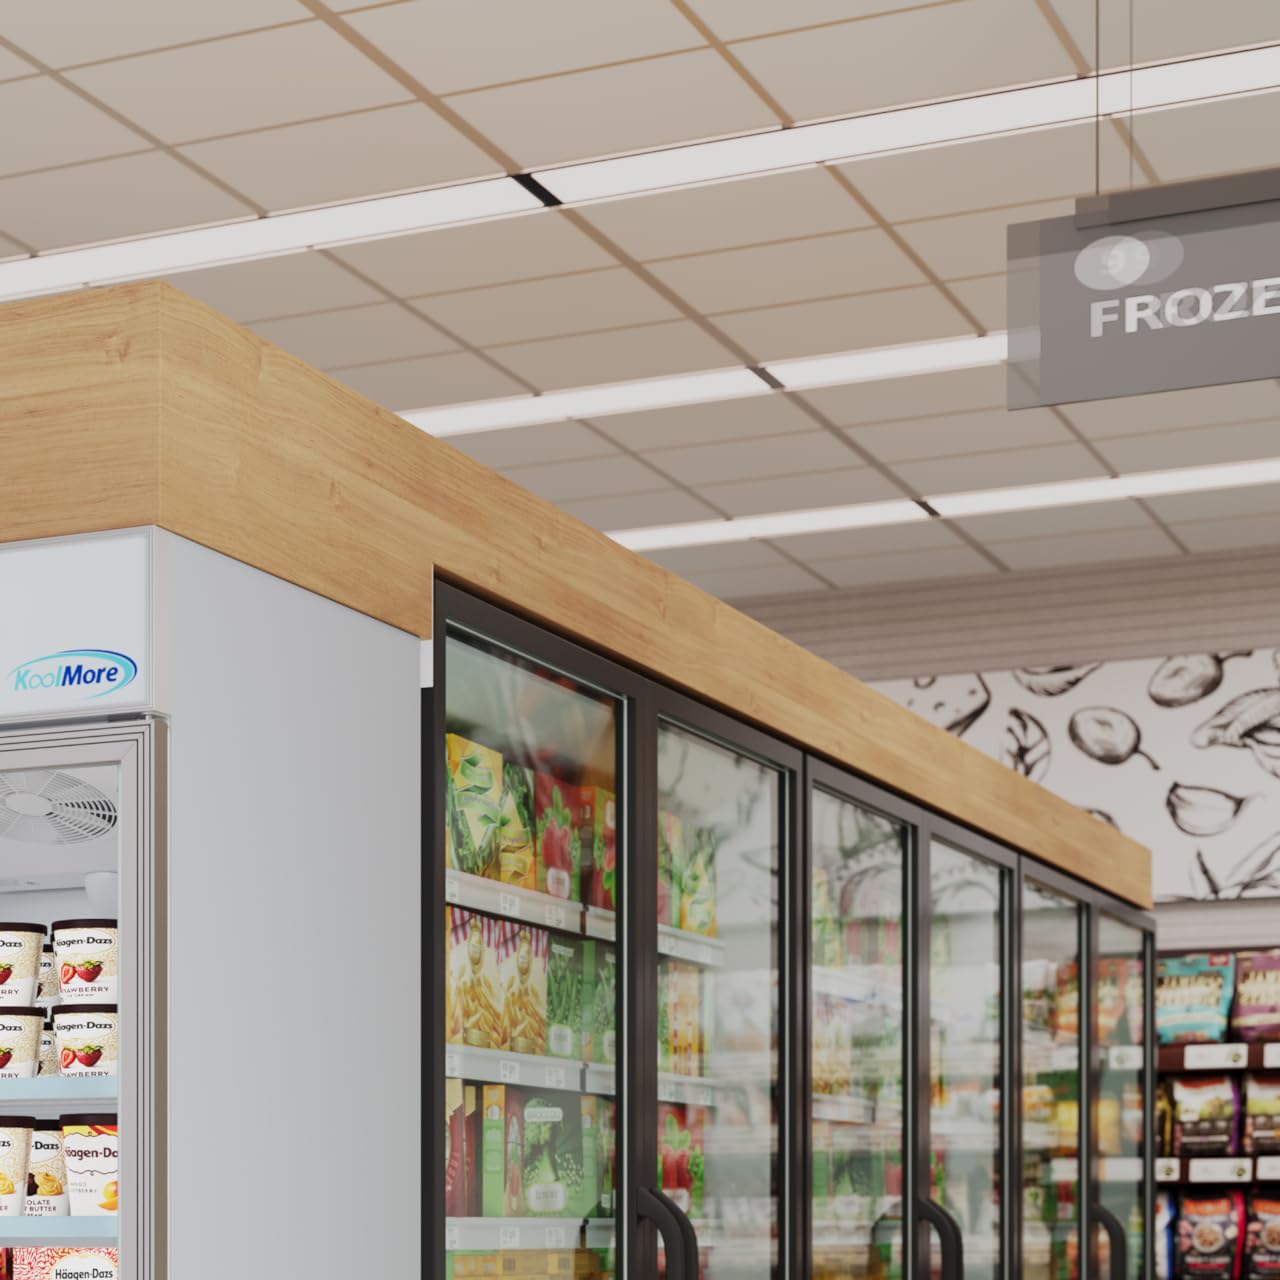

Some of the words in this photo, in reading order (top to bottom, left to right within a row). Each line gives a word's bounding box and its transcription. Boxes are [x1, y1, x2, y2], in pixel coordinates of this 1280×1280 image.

[1089, 276, 1280, 338] FROZE
[15, 664, 119, 691] KoolMore
[56, 937, 113, 947] äagen-Dazs
[56, 1022, 113, 1032] äagen-Dazs
[65, 1147, 118, 1160] äagen-D
